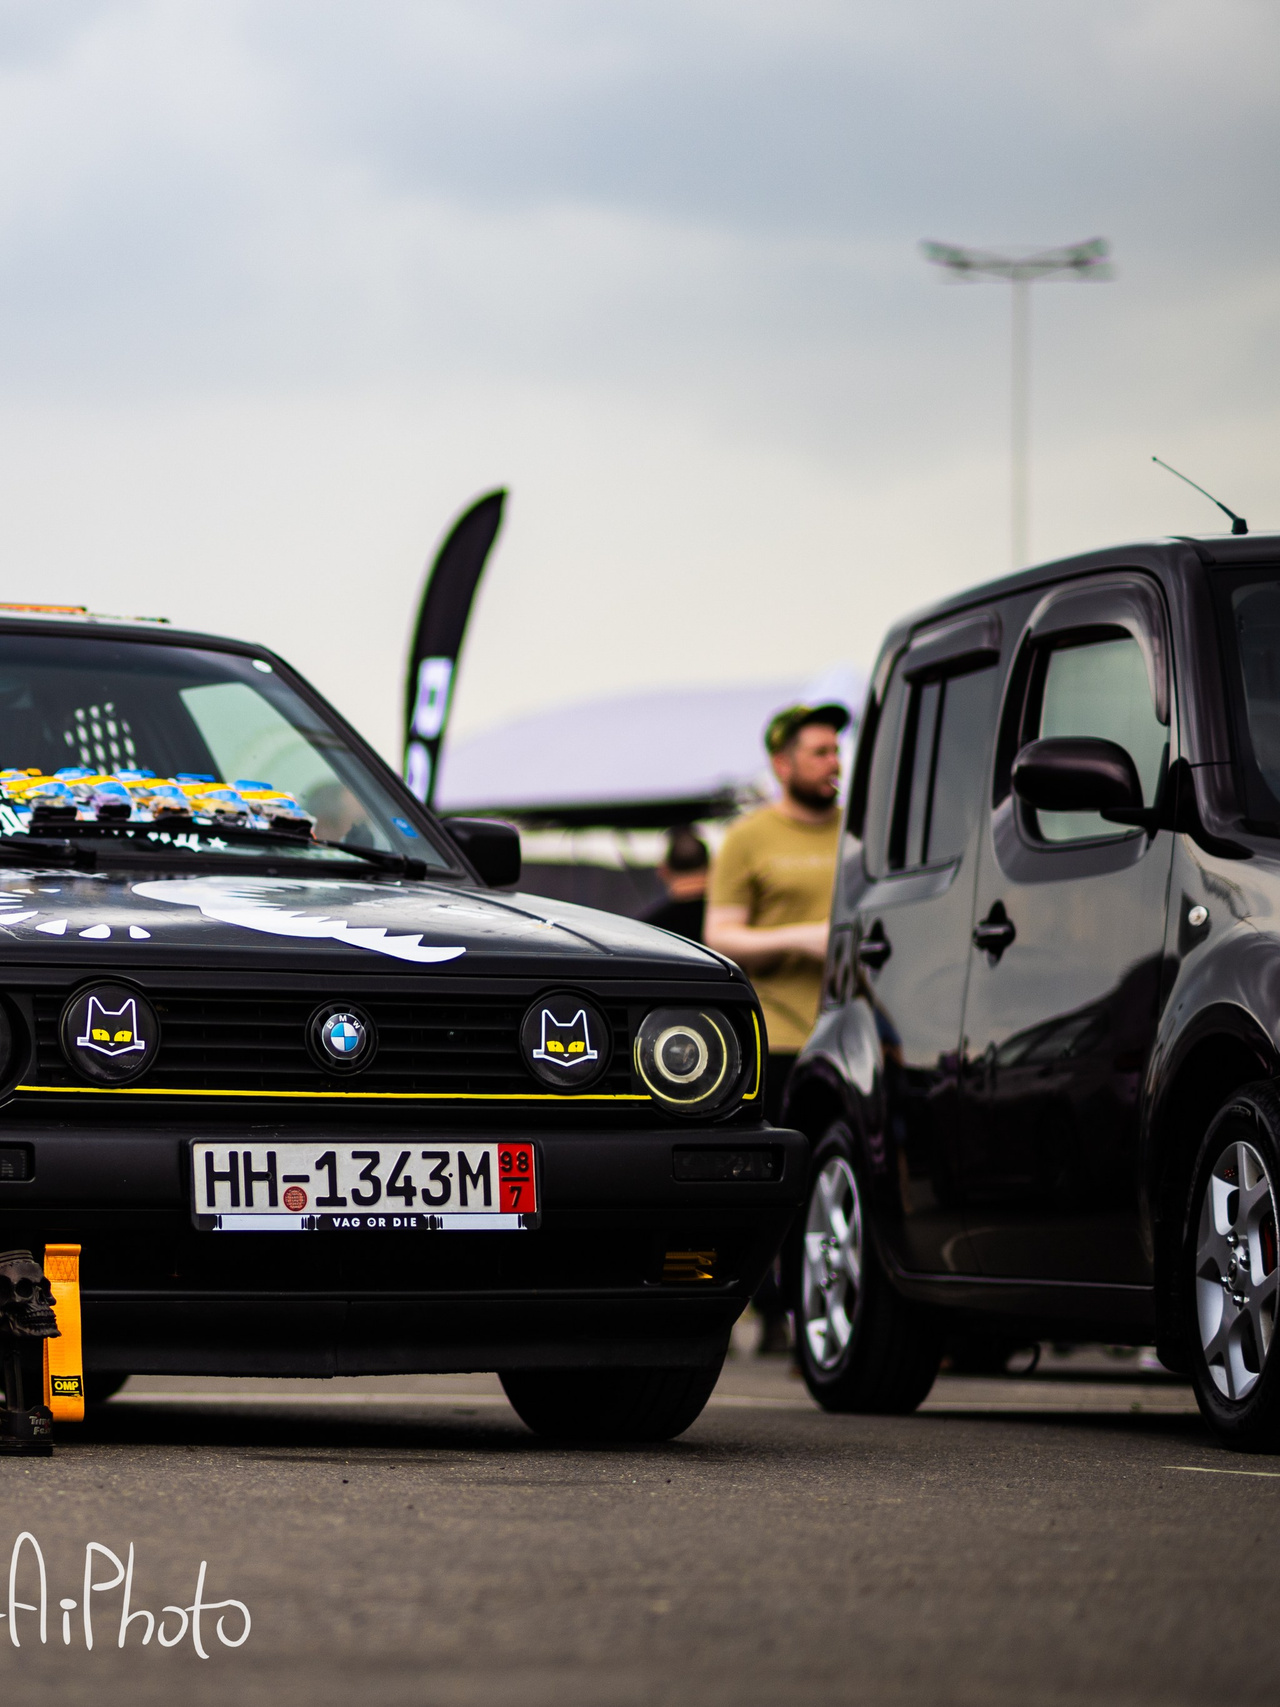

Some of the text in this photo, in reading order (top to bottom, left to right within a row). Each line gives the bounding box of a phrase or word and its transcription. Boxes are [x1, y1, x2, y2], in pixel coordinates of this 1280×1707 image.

[326, 1014, 361, 1030] BMW
[500, 1150, 530, 1173] 98
[204, 1150, 492, 1207] HH-1343M
[509, 1185, 523, 1208] 7
[332, 1217, 418, 1228] VAG OR DIE
[54, 1380, 79, 1391] OMP
